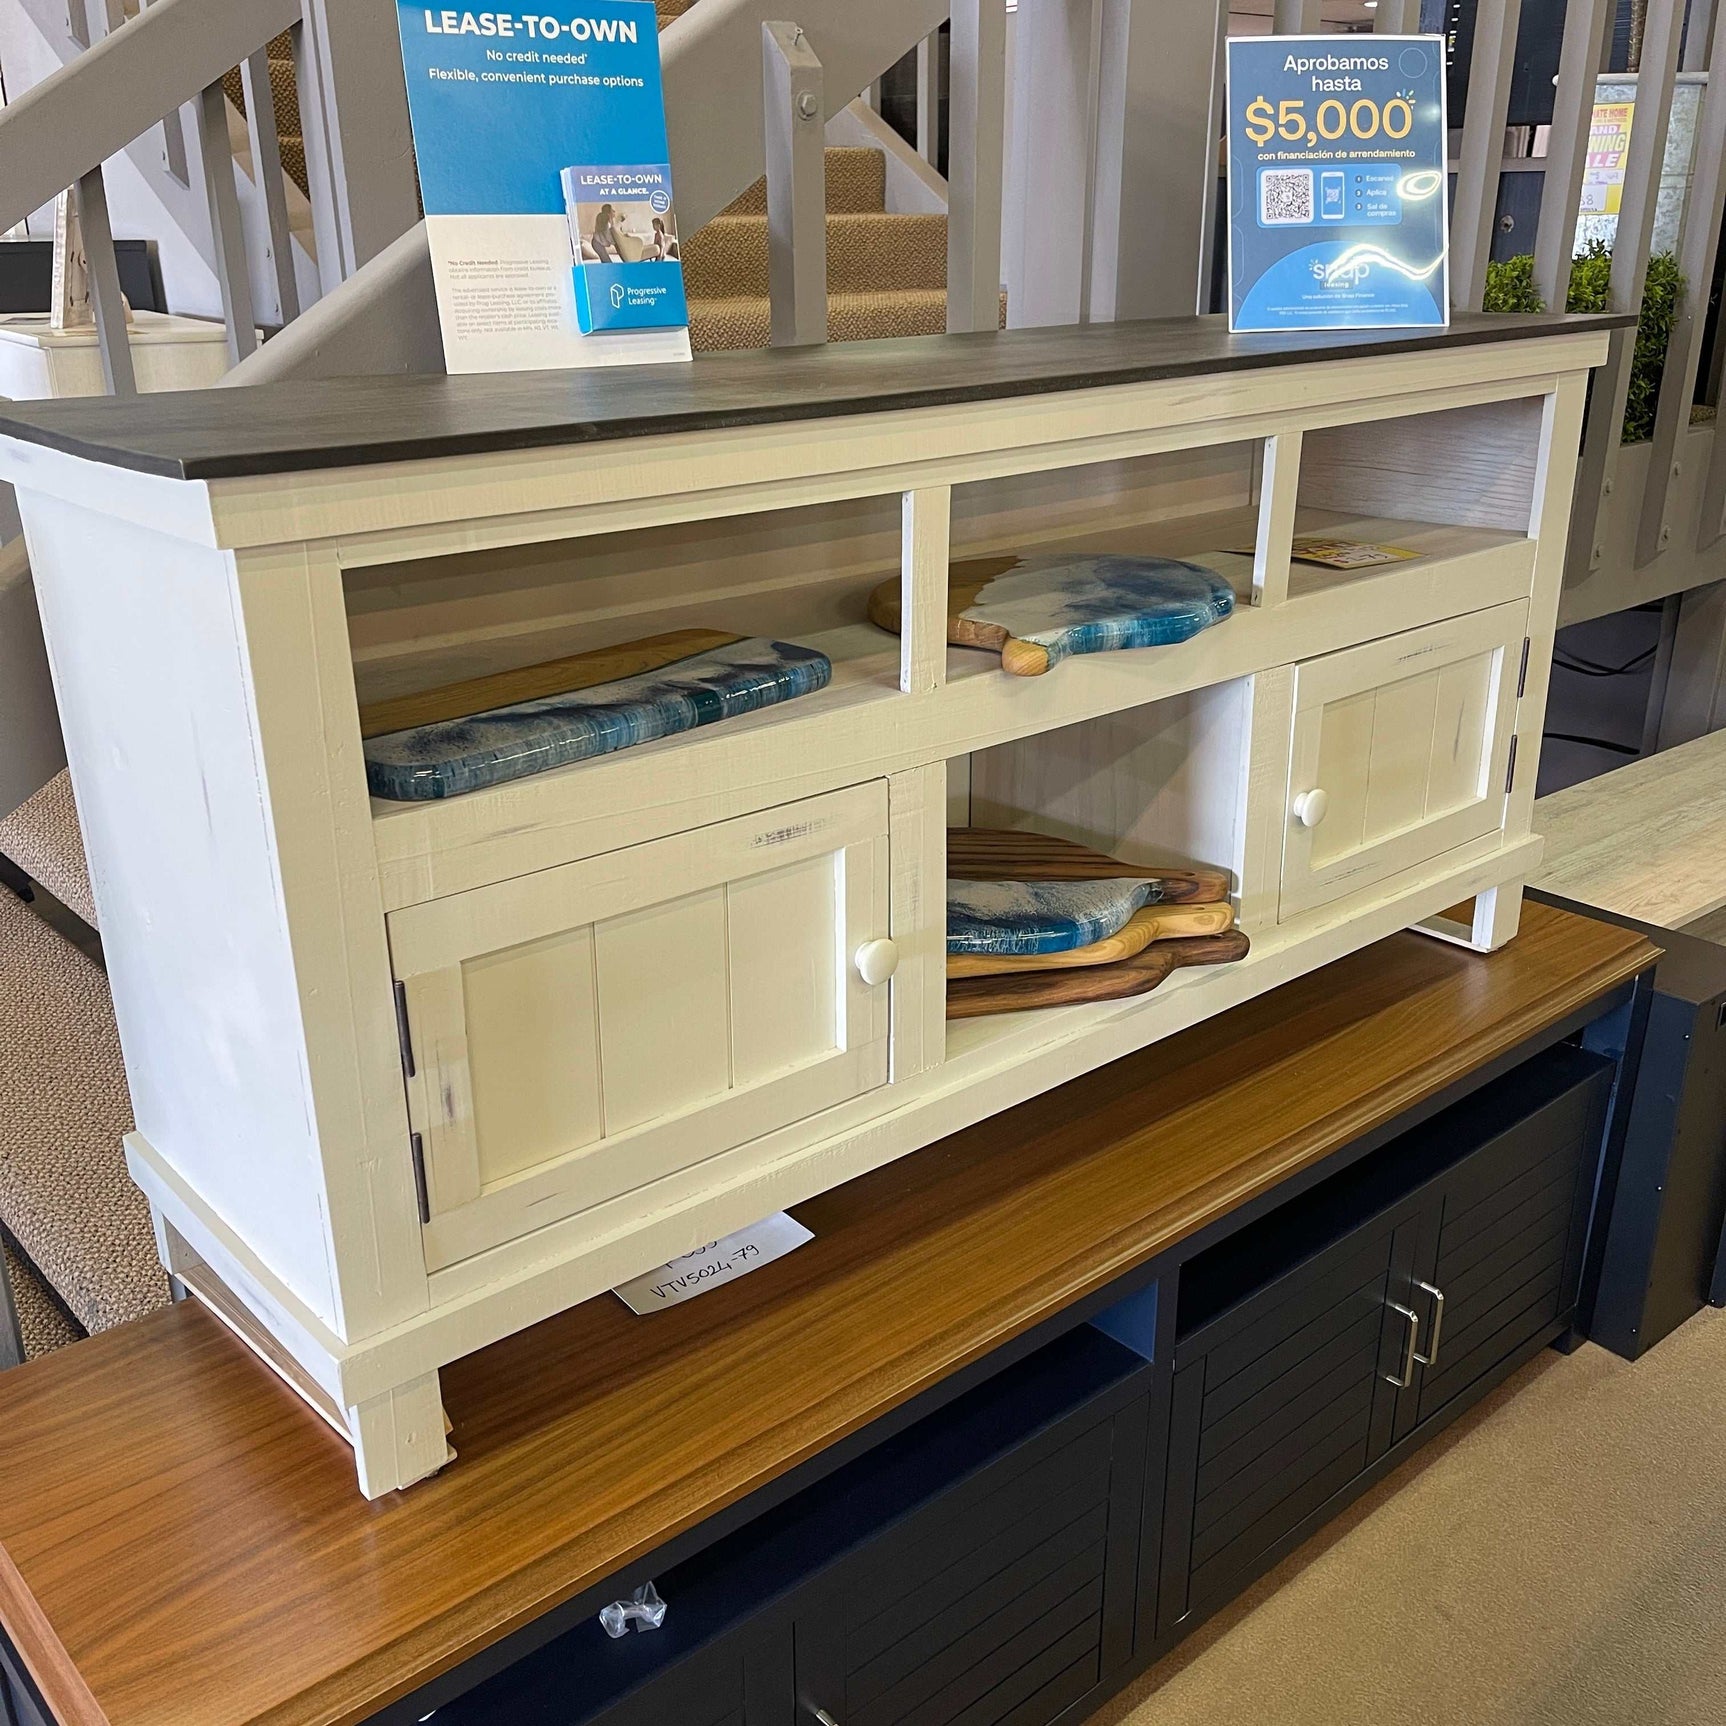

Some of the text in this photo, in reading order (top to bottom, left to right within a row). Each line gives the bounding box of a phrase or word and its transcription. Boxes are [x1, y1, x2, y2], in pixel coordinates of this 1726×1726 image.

[424, 10, 638, 44] LEASE-TO-OWN
[486, 50, 503, 61] No
[506, 50, 539, 62] credit
[1283, 54, 1388, 75] Aprobamos
[429, 68, 644, 87] Flexible, convenient purchase options
[1312, 77, 1362, 92] hasta
[1245, 96, 1413, 147] $5,000
[1258, 150, 1416, 161] con financiación de arrendamiento
[581, 174, 662, 185] LEASE-TO-OWN
[1366, 189, 1387, 197] Aplica
[627, 287, 666, 296] Progressive
